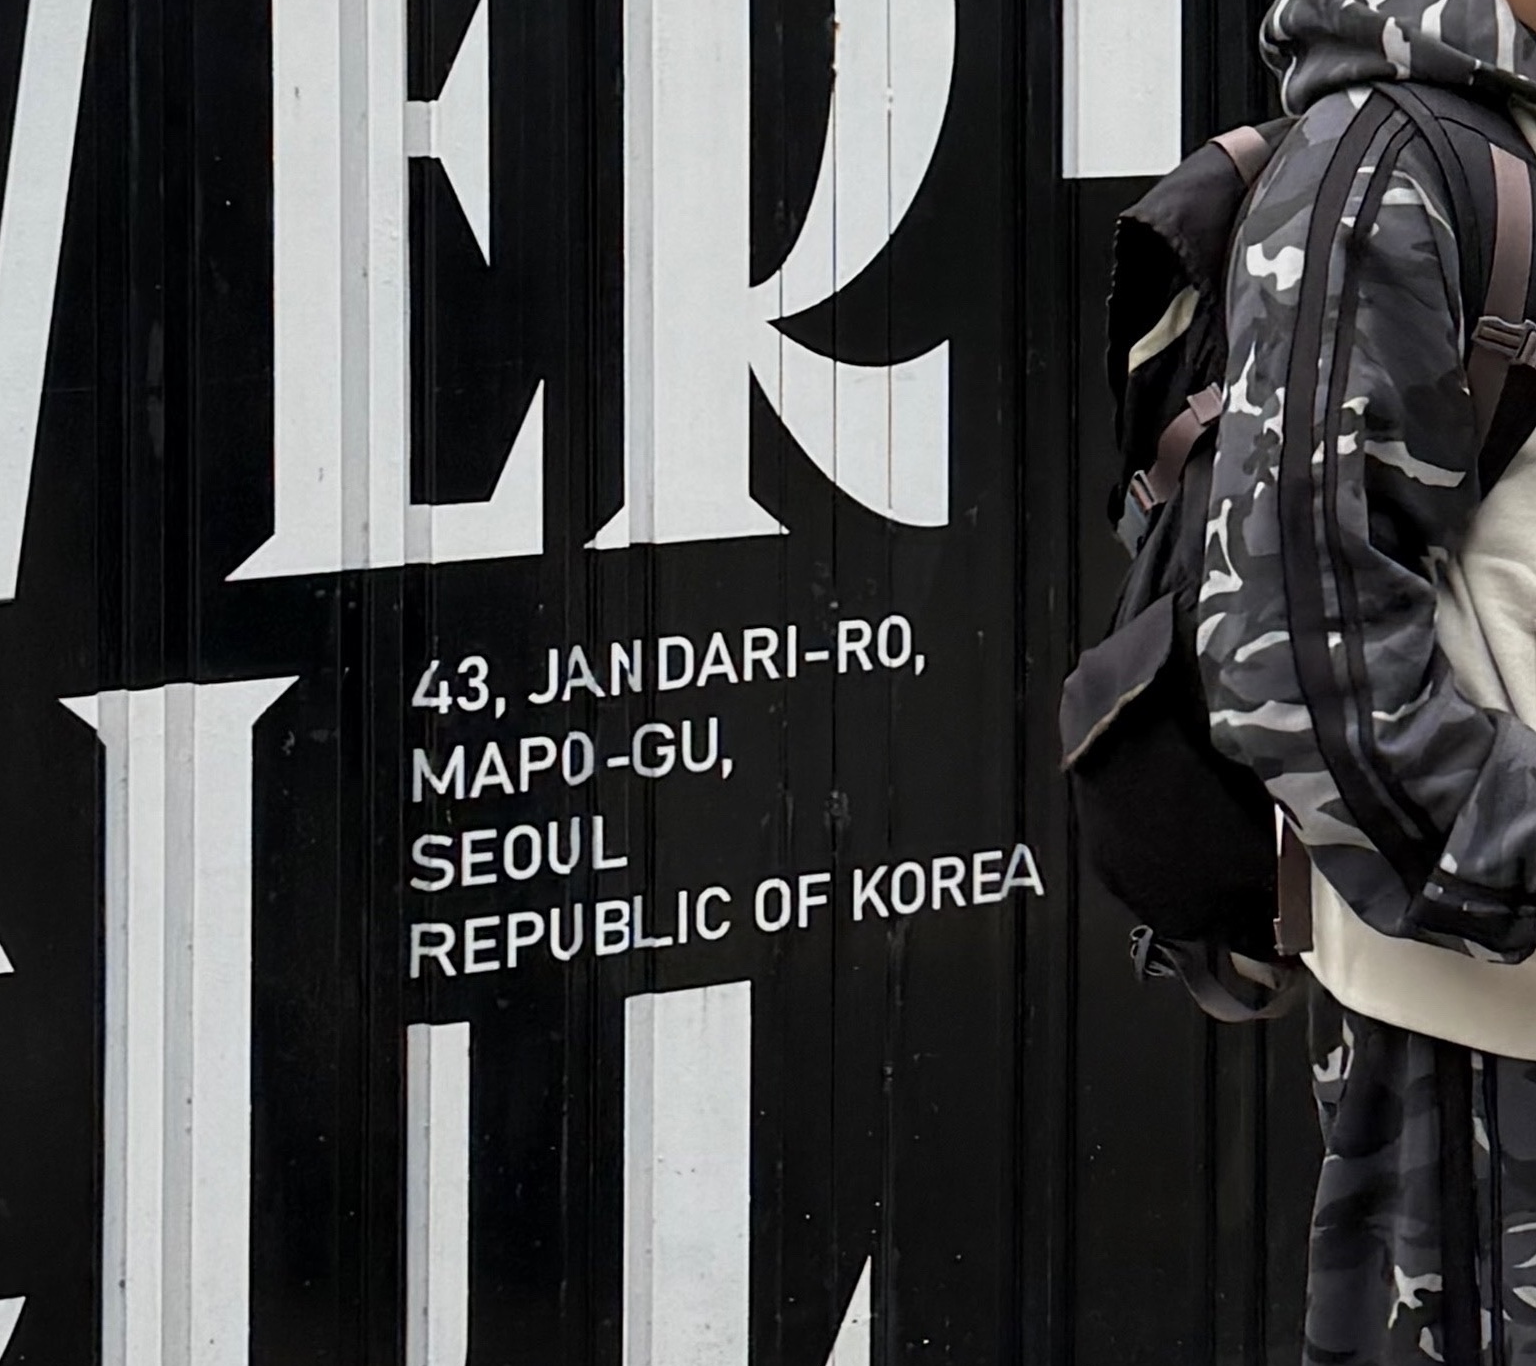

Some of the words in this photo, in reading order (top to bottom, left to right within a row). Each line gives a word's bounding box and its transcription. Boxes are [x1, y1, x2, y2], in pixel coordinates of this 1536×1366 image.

[412, 655, 506, 720] 43,
[528, 615, 925, 704] JANDARI-RO,
[413, 717, 733, 802] MAPO-GU,
[410, 815, 628, 892] SEOUL
[410, 886, 731, 978] REPUBLIC
[755, 873, 831, 932] OF
[853, 843, 1044, 921] KOREA
